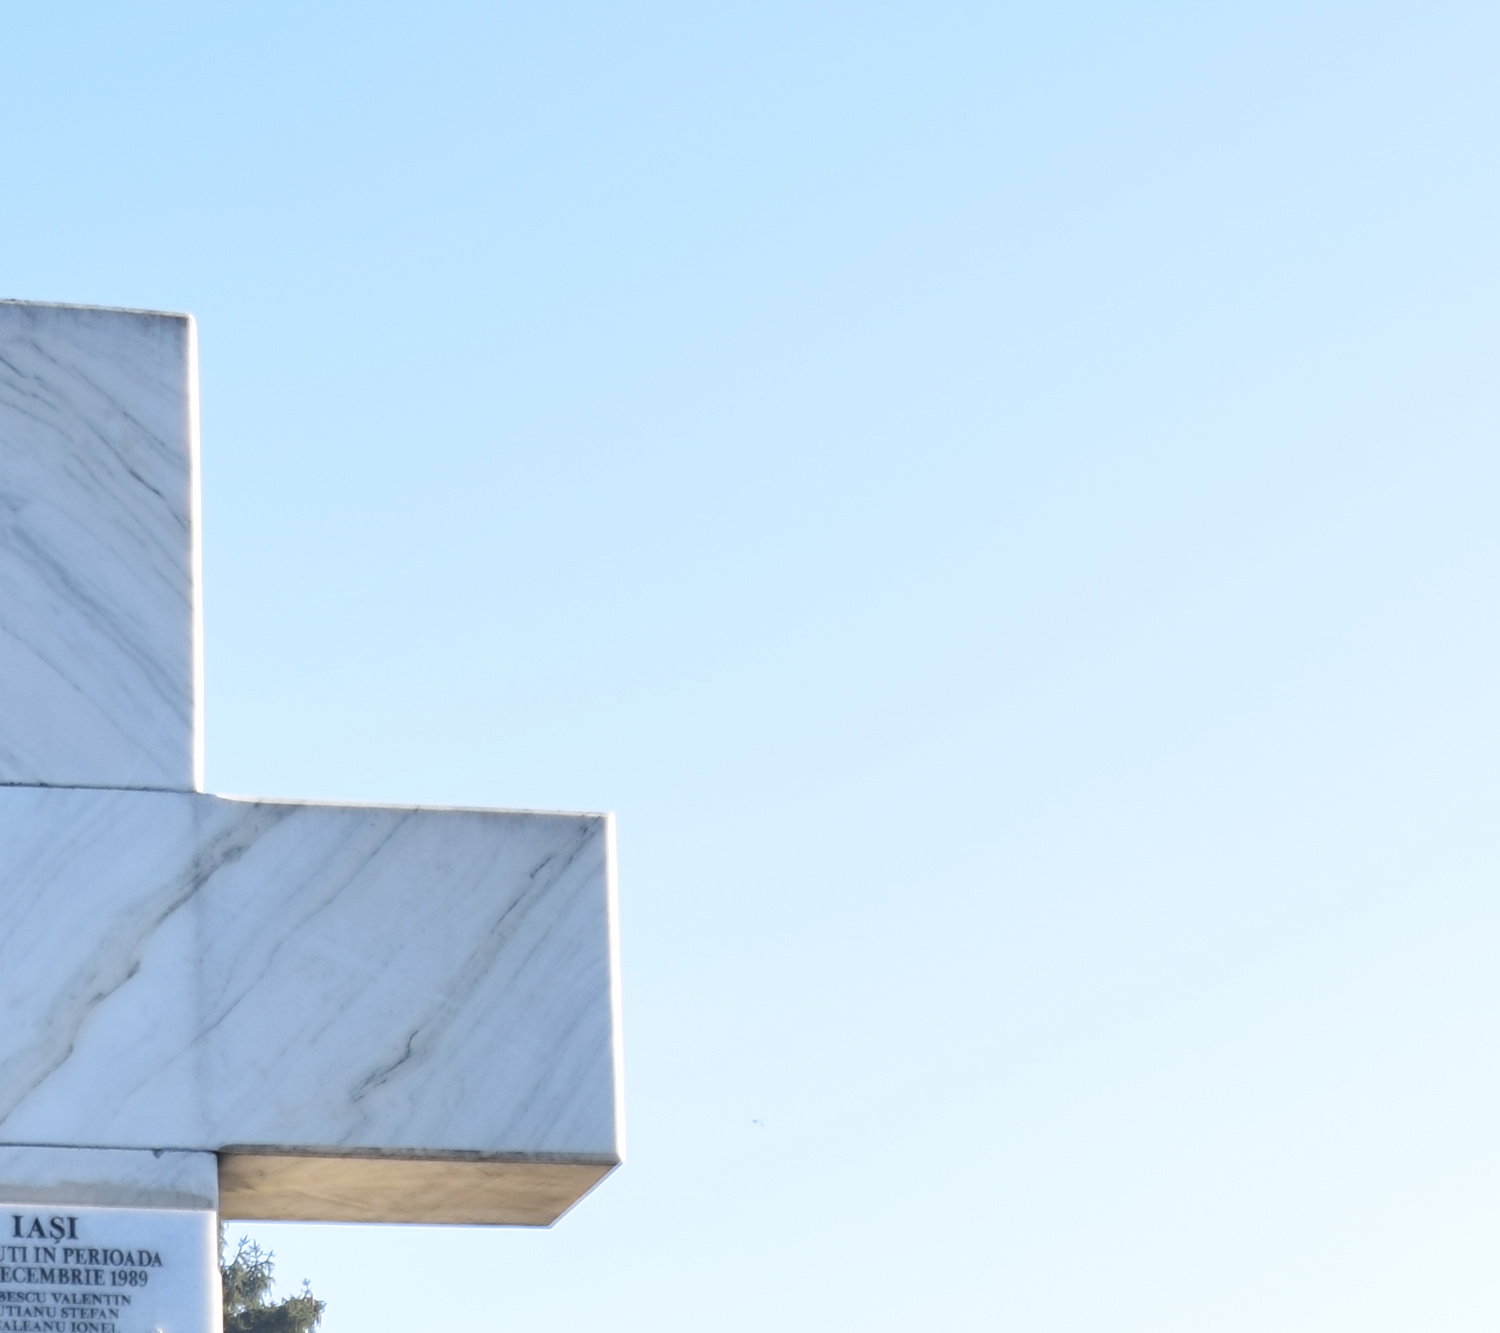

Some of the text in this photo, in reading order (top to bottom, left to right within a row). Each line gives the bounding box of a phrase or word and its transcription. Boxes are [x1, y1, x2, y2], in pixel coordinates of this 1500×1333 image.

[34, 1246, 56, 1264] IN
[64, 1248, 162, 1267] PERIOADA
[111, 1270, 148, 1287] 1989
